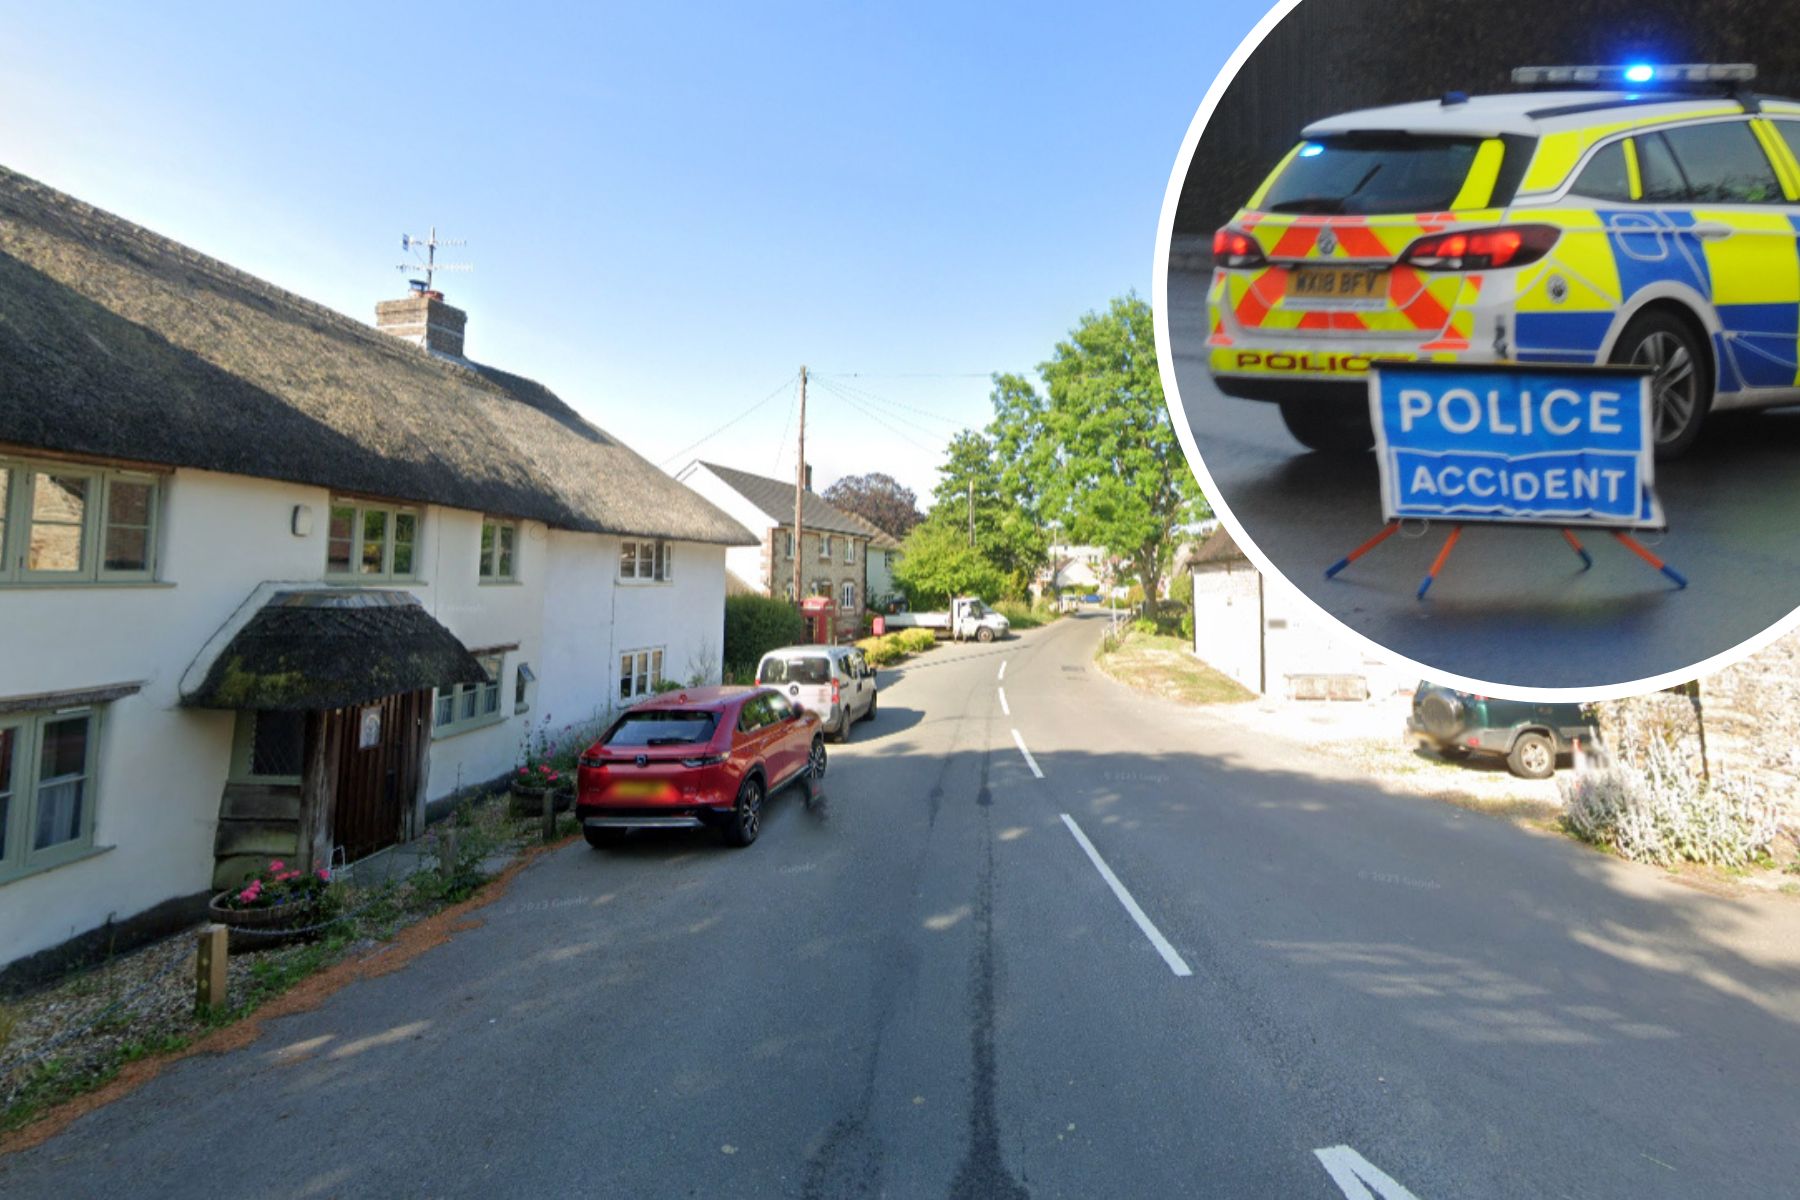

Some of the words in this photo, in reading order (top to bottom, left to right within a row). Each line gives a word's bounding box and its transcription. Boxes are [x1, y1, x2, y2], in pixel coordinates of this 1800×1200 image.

[1340, 270, 1378, 294] BFV
[1237, 353, 1409, 372] POLIC
[1399, 388, 1623, 436] POLICE
[1410, 465, 1627, 503] ACCIDENT
